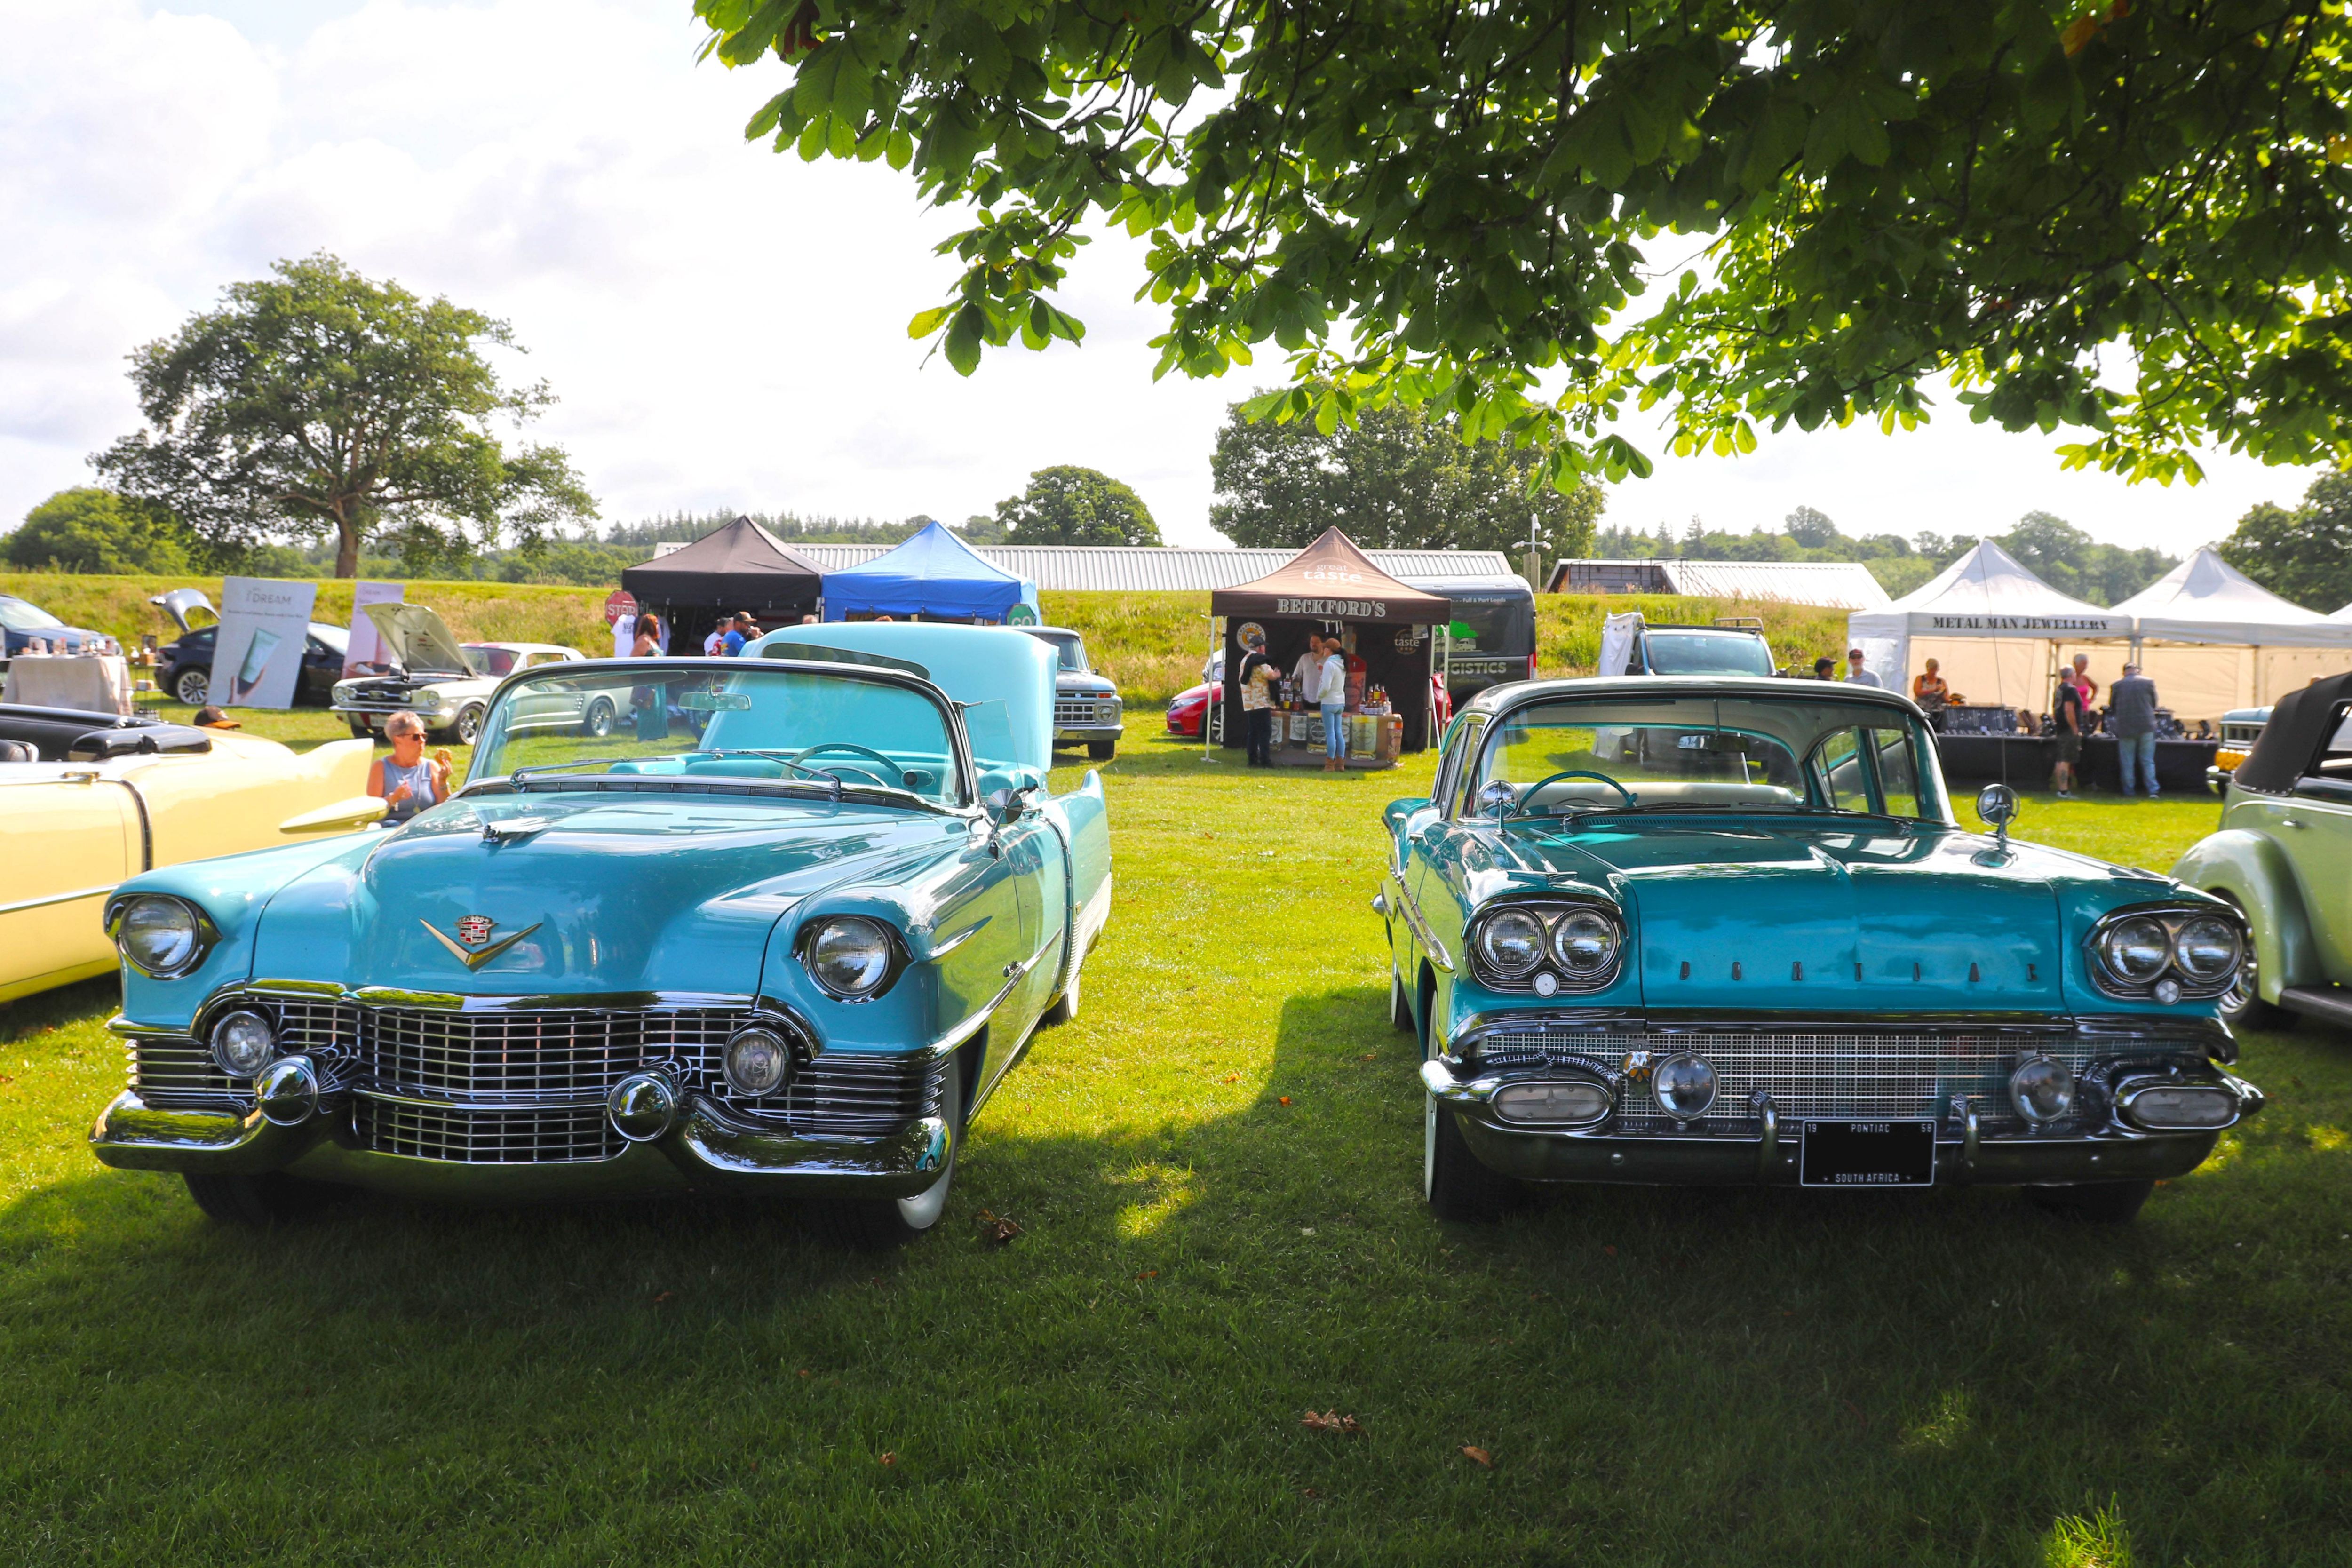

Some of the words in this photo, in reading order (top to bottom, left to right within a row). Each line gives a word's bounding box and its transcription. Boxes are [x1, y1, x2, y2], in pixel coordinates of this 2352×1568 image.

[1303, 571, 1363, 582] taste
[1276, 598, 1386, 617] BECKFORD'S
[1933, 617, 1982, 629] METAL
[1986, 618, 2018, 629] MAN
[2023, 618, 2109, 629] JEWELLERY
[1808, 1124, 1817, 1133] 19
[1851, 1124, 1890, 1133] PONTIAC
[1921, 1124, 1932, 1133] 58
[1836, 1174, 1864, 1183] SOUTH
[1867, 1173, 1899, 1183] AFRICA
